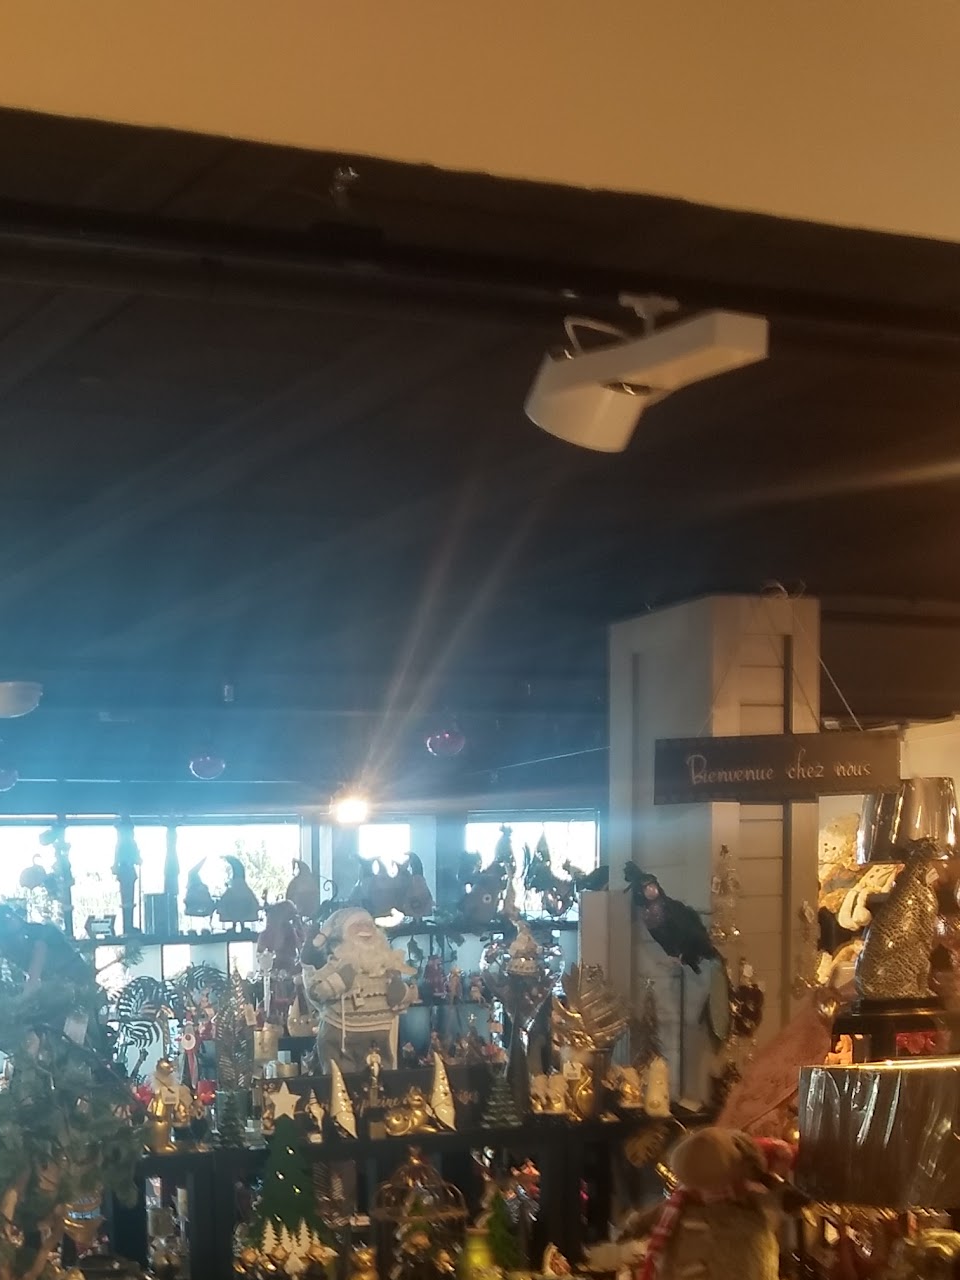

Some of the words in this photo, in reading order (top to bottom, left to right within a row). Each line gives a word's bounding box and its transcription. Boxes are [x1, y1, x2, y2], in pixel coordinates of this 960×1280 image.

[686, 754, 775, 785] Bienvenue
[786, 748, 824, 780] chez
[835, 761, 871, 778] nous
